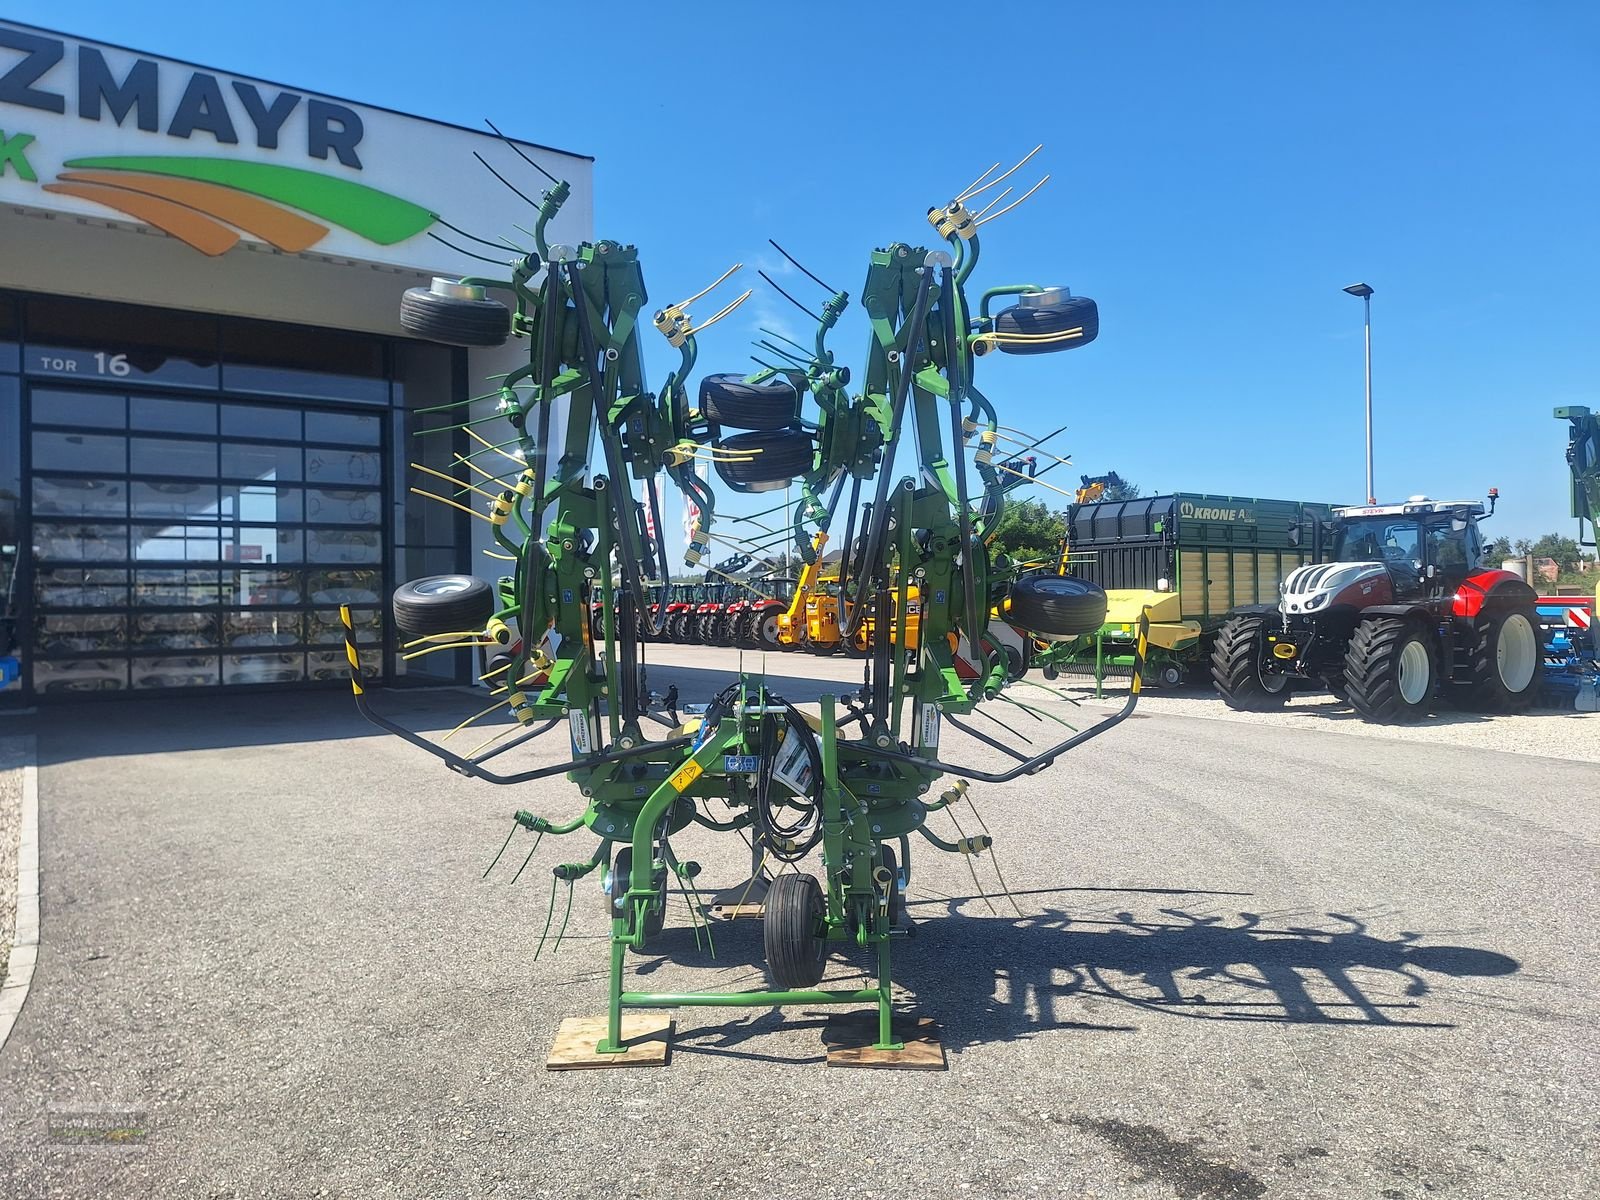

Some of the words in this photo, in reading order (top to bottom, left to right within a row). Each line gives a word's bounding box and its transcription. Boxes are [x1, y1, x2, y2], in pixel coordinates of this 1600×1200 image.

[0, 28, 364, 170] ZMAYR
[41, 357, 77, 372] TOR
[94, 352, 130, 376] 16
[1194, 507, 1236, 521] KRONE
